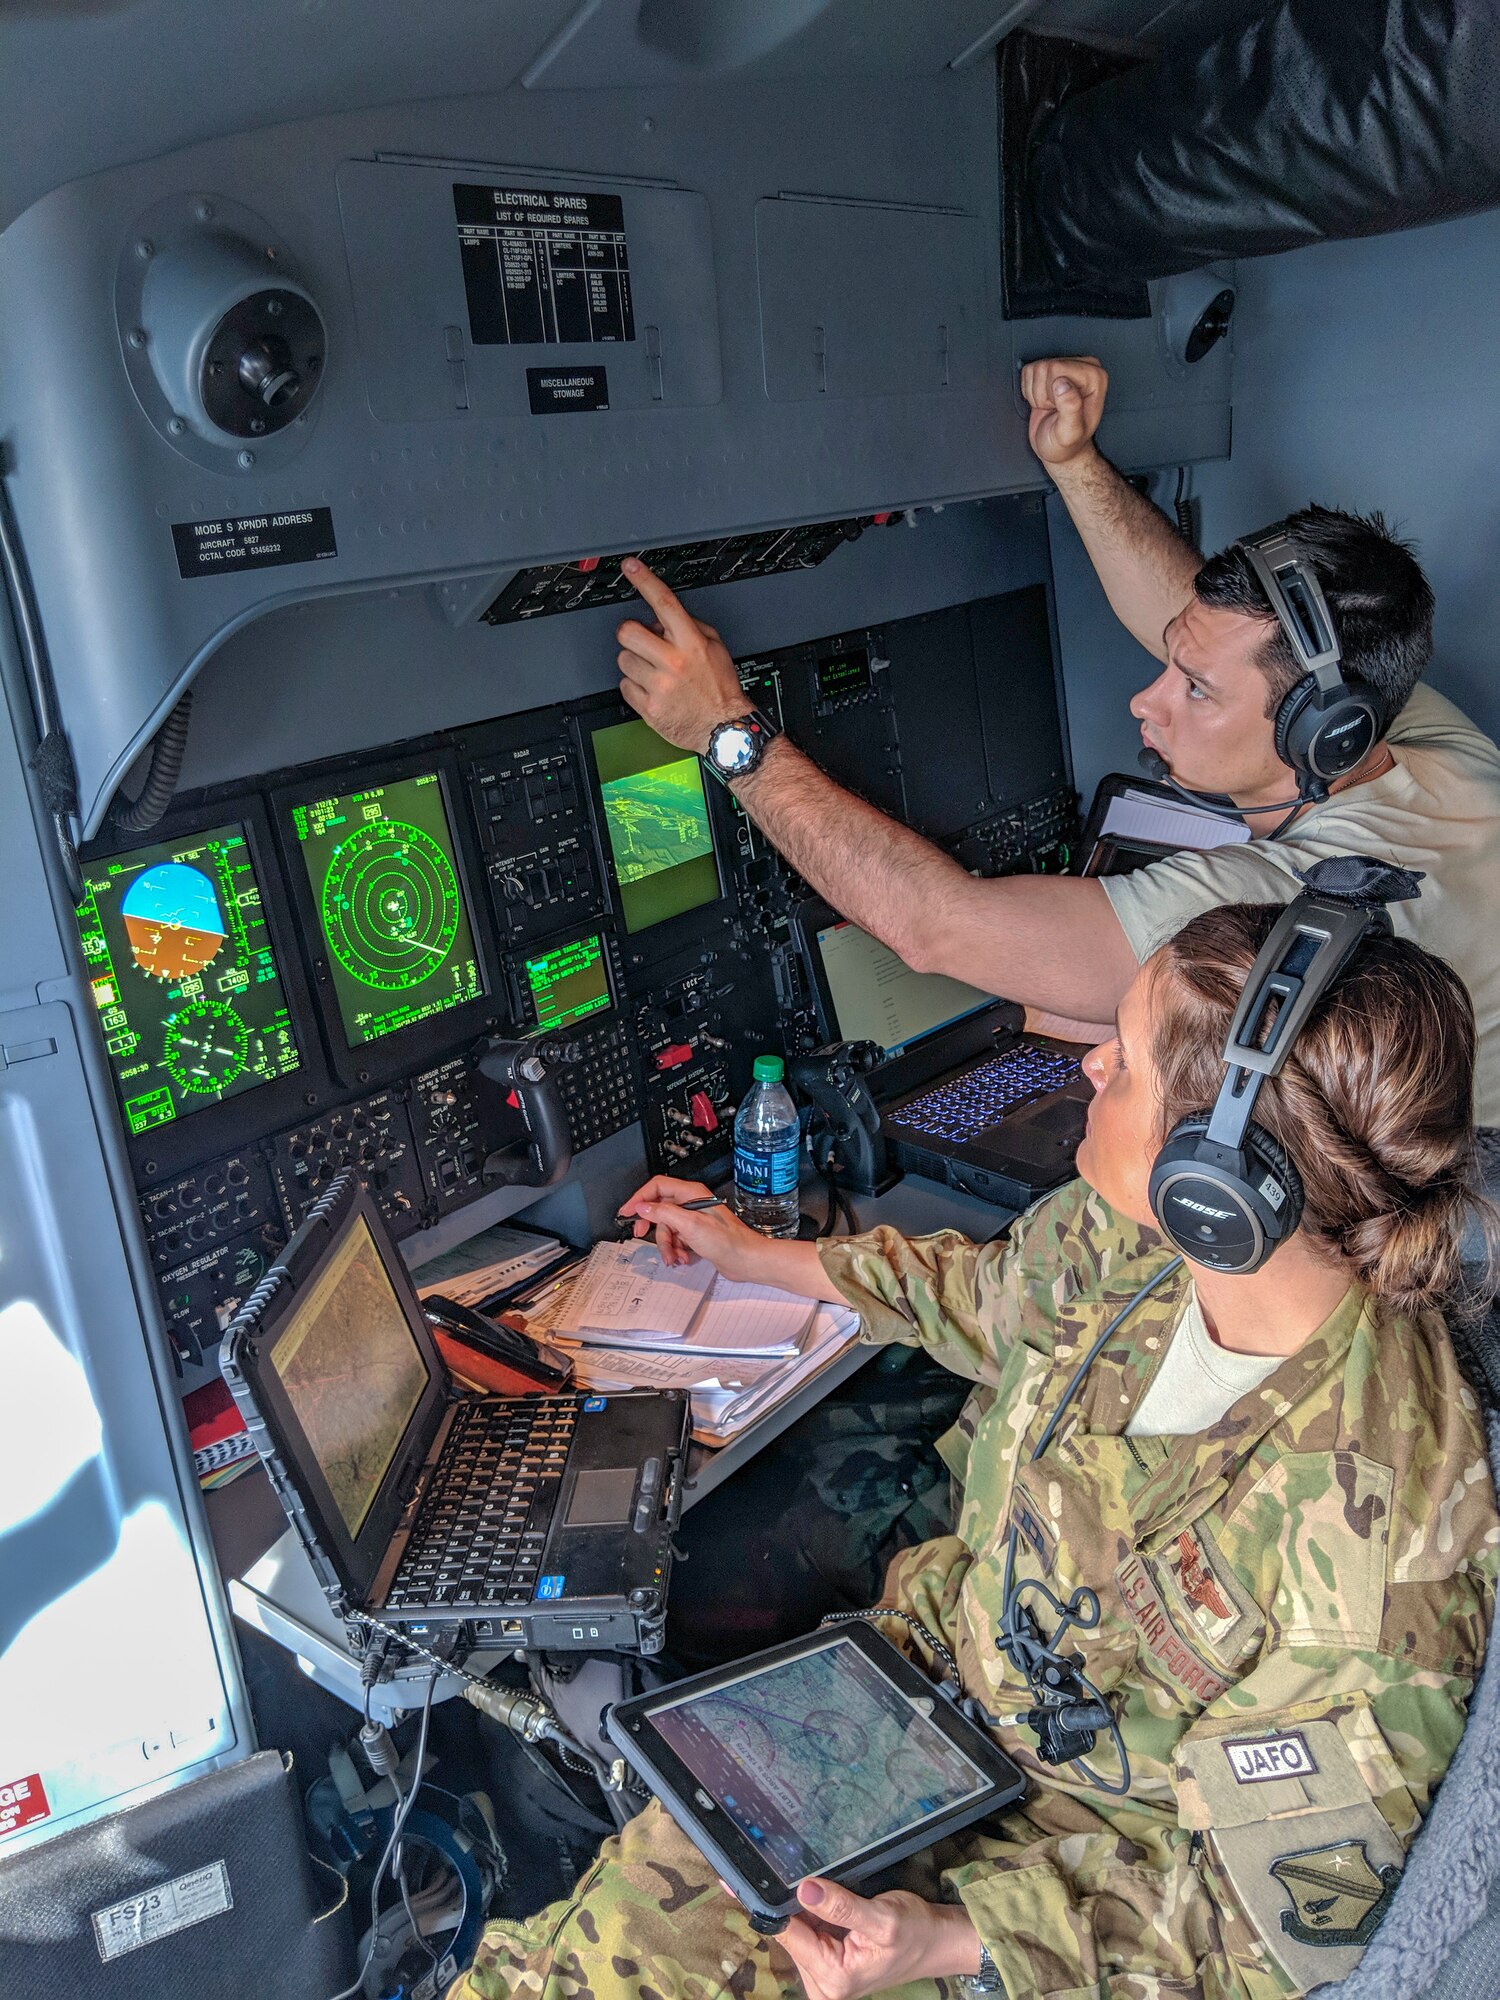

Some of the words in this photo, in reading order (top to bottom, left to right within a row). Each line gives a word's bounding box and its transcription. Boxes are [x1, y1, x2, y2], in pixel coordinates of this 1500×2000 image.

[493, 191, 550, 208] ELECTRICAL
[554, 196, 588, 210] SPARES
[496, 211, 511, 221] LIST
[514, 212, 525, 222] OF
[527, 213, 561, 224] REQUIRED
[564, 215, 590, 226] SPARES
[476, 228, 490, 236] NAME
[540, 377, 595, 388] MISCELLANEOUS
[553, 388, 585, 399] STOWAGE
[194, 523, 223, 537] MODE
[226, 522, 233, 532] S
[237, 518, 268, 531] XPNDR
[272, 513, 313, 527] ADDRESS
[200, 538, 236, 551] AIRCRAFT
[243, 535, 259, 545] 5827
[199, 551, 224, 562] OCTAL
[225, 548, 246, 558] CODE
[251, 544, 281, 555] 53456232
[1324, 714, 1366, 739] BOSE
[513, 749, 530, 759] RADAR
[480, 775, 496, 784] POWER
[500, 770, 511, 778] TEST
[365, 807, 379, 817] 295
[294, 814, 307, 823] ETA
[558, 838, 577, 847] FUNCTION
[173, 854, 185, 864] ALT
[188, 851, 200, 860] SEL
[495, 857, 516, 868] INTENSITY
[75, 906, 90, 917] 180
[82, 931, 96, 940] 160
[88, 956, 103, 965] 140
[228, 974, 248, 986] 1400
[682, 977, 698, 990] LOCK
[184, 982, 200, 994] 295
[108, 1015, 124, 1026] 163
[118, 1036, 134, 1048] 1.1
[120, 1063, 150, 1080] 2058:30
[418, 1068, 439, 1083] CURSOR
[441, 1058, 465, 1073] CONTROL
[440, 1072, 450, 1081] TILT
[454, 1071, 467, 1080] RESET
[667, 1076, 687, 1091] DEFENSIVE
[687, 1067, 705, 1080] SYSTEMS
[369, 1100, 377, 1108] PA
[151, 1105, 169, 1117] DIST
[430, 1105, 449, 1117] DISPLAY
[134, 1120, 148, 1131] 237
[359, 1137, 369, 1146] SAT
[389, 1150, 403, 1160] RADIO
[1216, 1152, 1223, 1160] R
[228, 1158, 240, 1168] BCN
[734, 1157, 769, 1178] ASANI
[149, 1187, 175, 1202] TACAN-1
[177, 1178, 196, 1190] ADF-1
[235, 1191, 249, 1201] RWR
[1265, 1182, 1281, 1202] 439
[1172, 1196, 1237, 1220] BOSE
[157, 1222, 184, 1238] TACAN-2
[185, 1212, 205, 1225] ADF-2
[161, 1266, 189, 1283] OXYGEN
[191, 1246, 229, 1269] REGULATOR
[176, 1269, 199, 1282] PRESSURE
[201, 1259, 219, 1271] DEMAND
[173, 1307, 190, 1320] FLOW
[1135, 1600, 1165, 1646] AIR
[1157, 1635, 1228, 1702] FORC
[1240, 1742, 1303, 1776] JAFO
[778, 1791, 796, 1809] KLBT
[109, 1894, 161, 1927] FS23
[179, 1872, 213, 1891] QinetiQ
